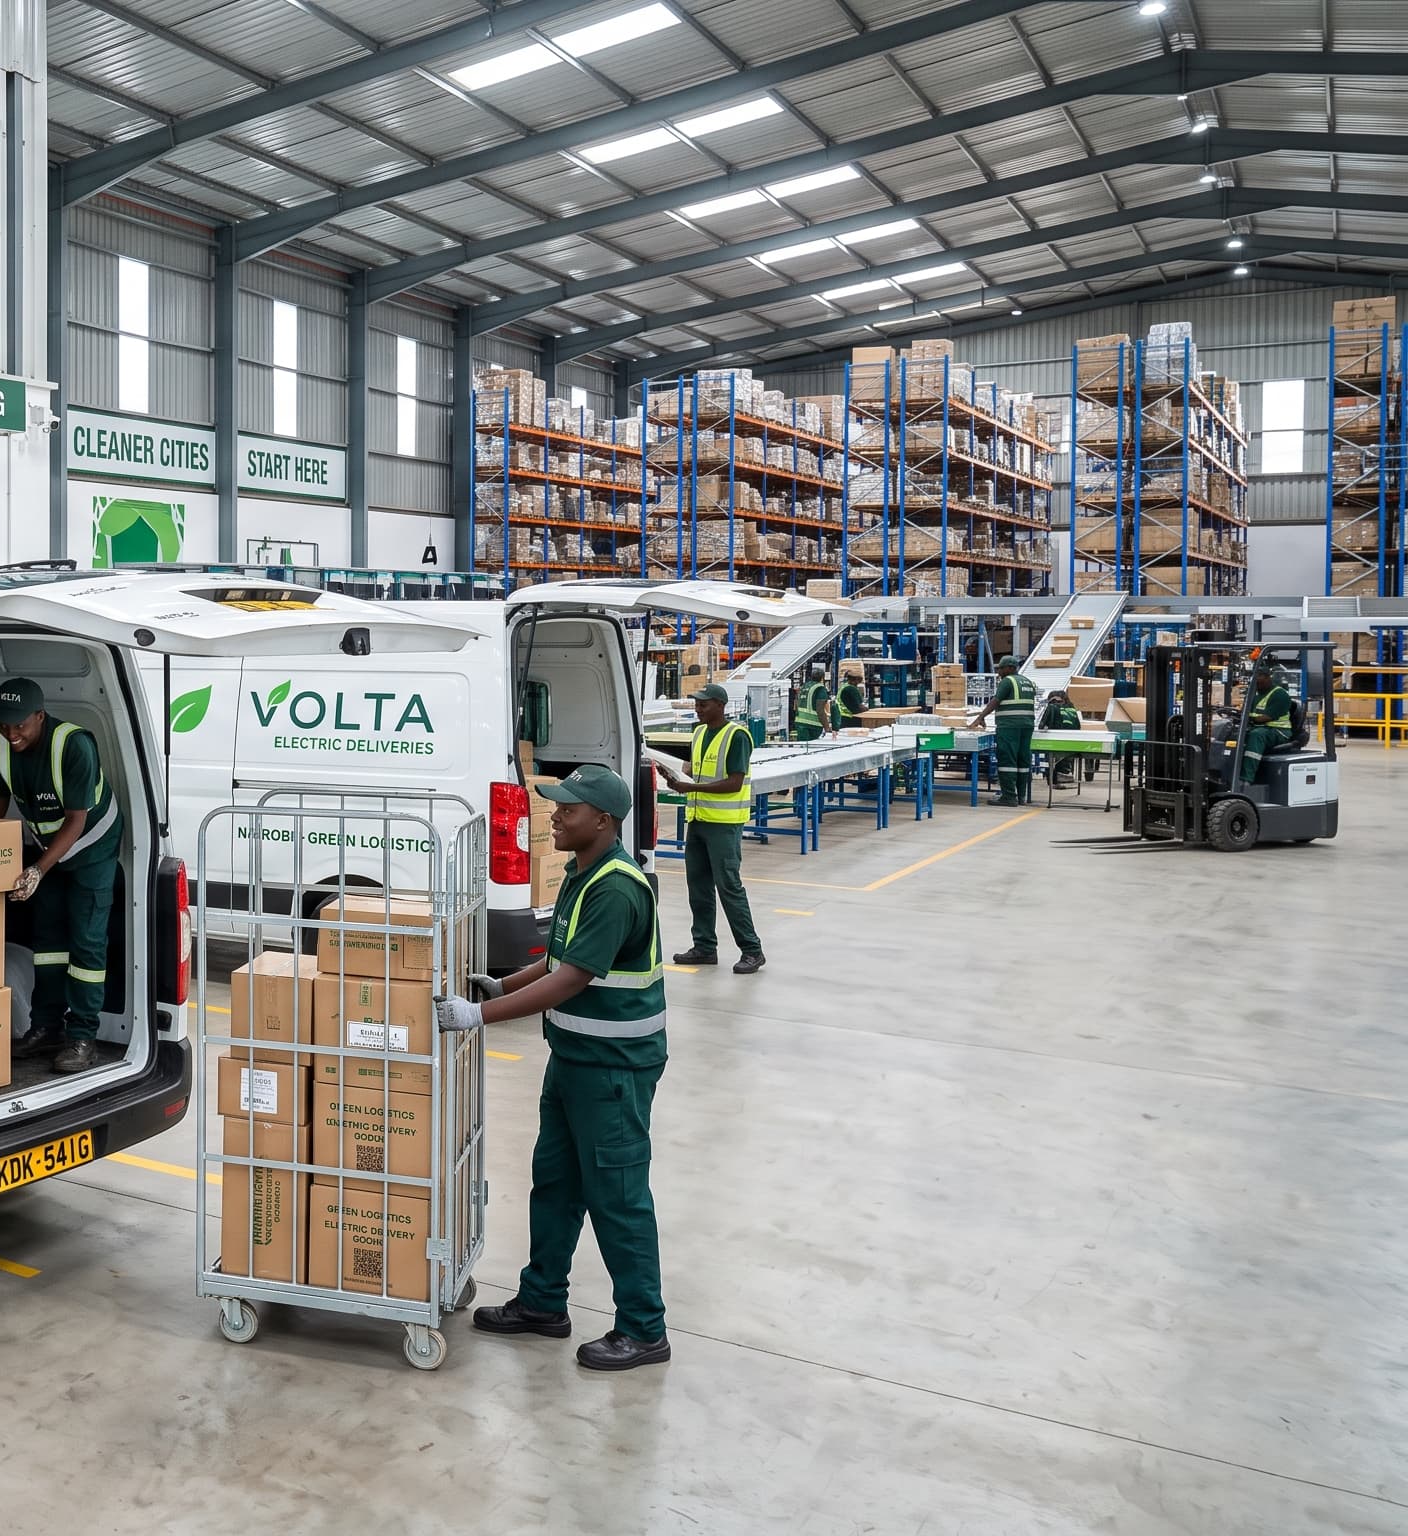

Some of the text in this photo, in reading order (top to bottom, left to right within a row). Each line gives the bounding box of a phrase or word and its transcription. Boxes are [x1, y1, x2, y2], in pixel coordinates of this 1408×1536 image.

[73, 425, 209, 472] CLEANER CITIES
[247, 450, 328, 485] START HERE
[250, 691, 434, 733] VOLTA
[274, 736, 434, 754] ELECTRIC DELIVERIES
[238, 827, 294, 842] NROBI
[364, 1106, 415, 1120] LOGSTICS
[361, 1209, 412, 1224] LOGTICS
[324, 1220, 415, 1241] ELTRIC DEVERY
